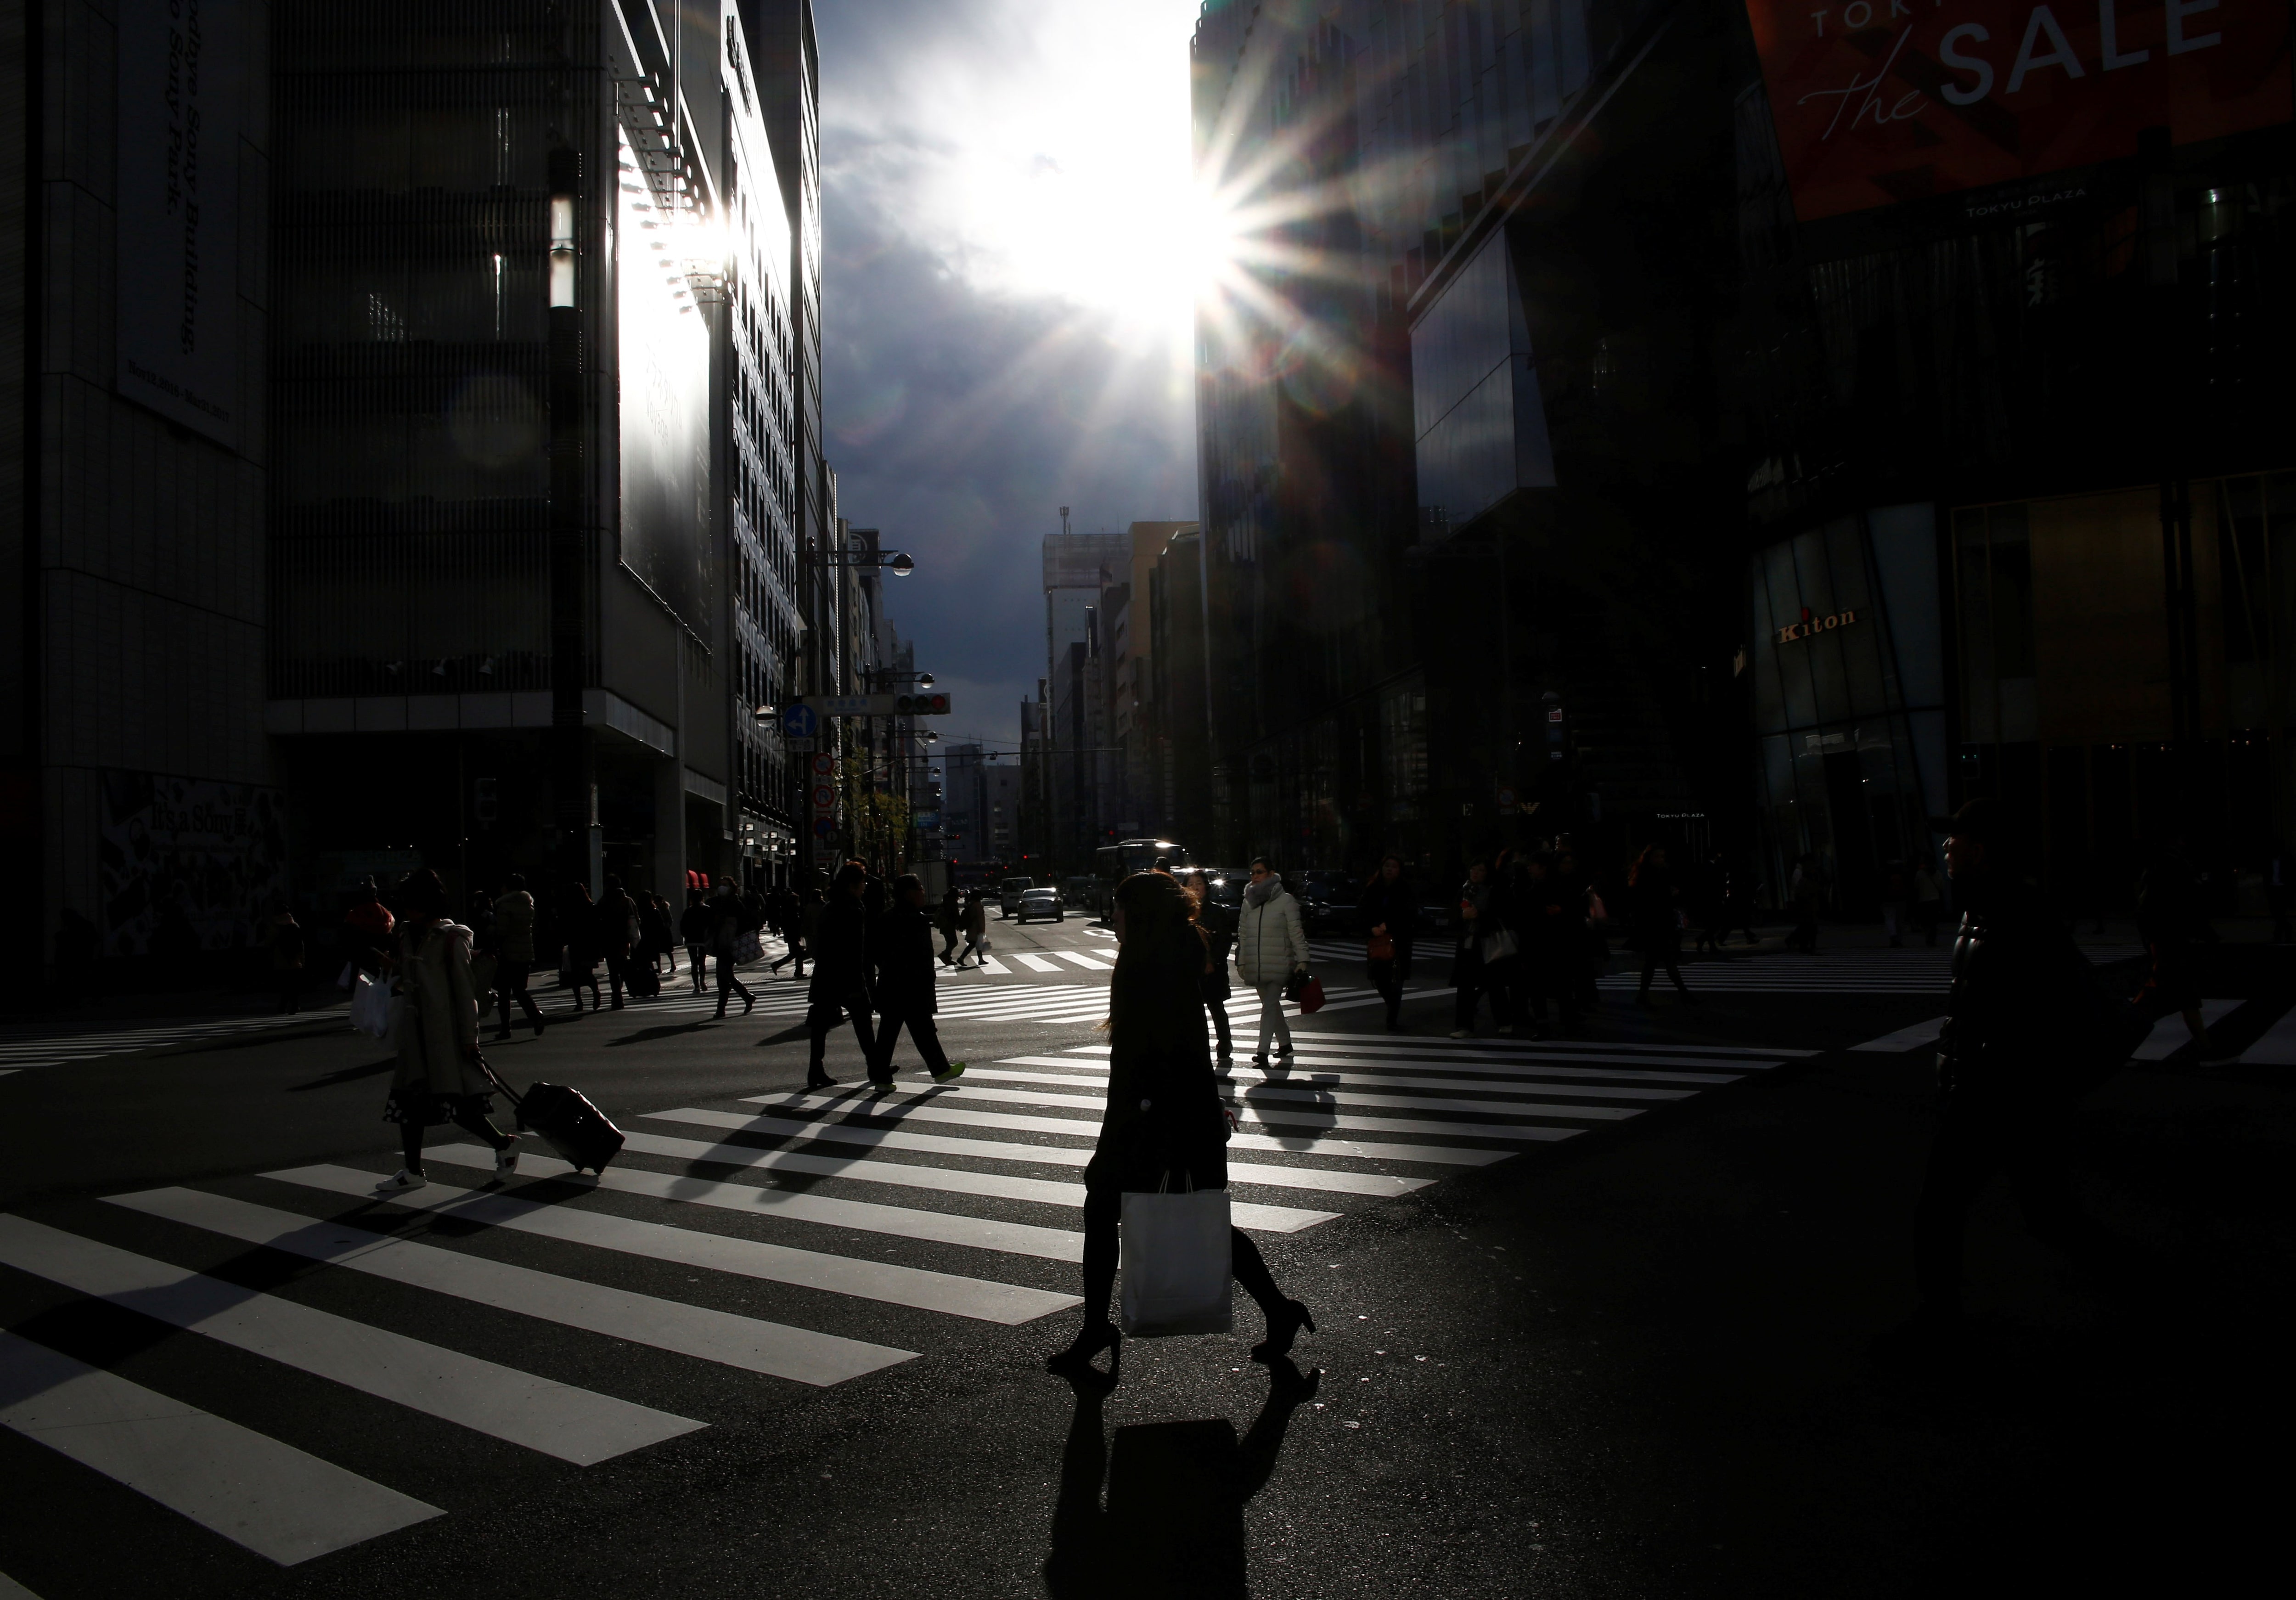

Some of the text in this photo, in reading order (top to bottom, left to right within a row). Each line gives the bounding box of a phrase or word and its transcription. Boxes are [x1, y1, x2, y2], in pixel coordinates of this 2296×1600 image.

[1811, 0, 1941, 38] TOK
[165, 27, 183, 119] Sony
[1938, 0, 2222, 106] SALE
[168, 122, 182, 215] Park.
[184, 104, 200, 194] Sony
[1966, 200, 2021, 218] TOKYU
[2028, 188, 2086, 206] PLAZA
[1778, 608, 1856, 645] Kiton
[151, 802, 174, 831] It's
[179, 811, 190, 832] a
